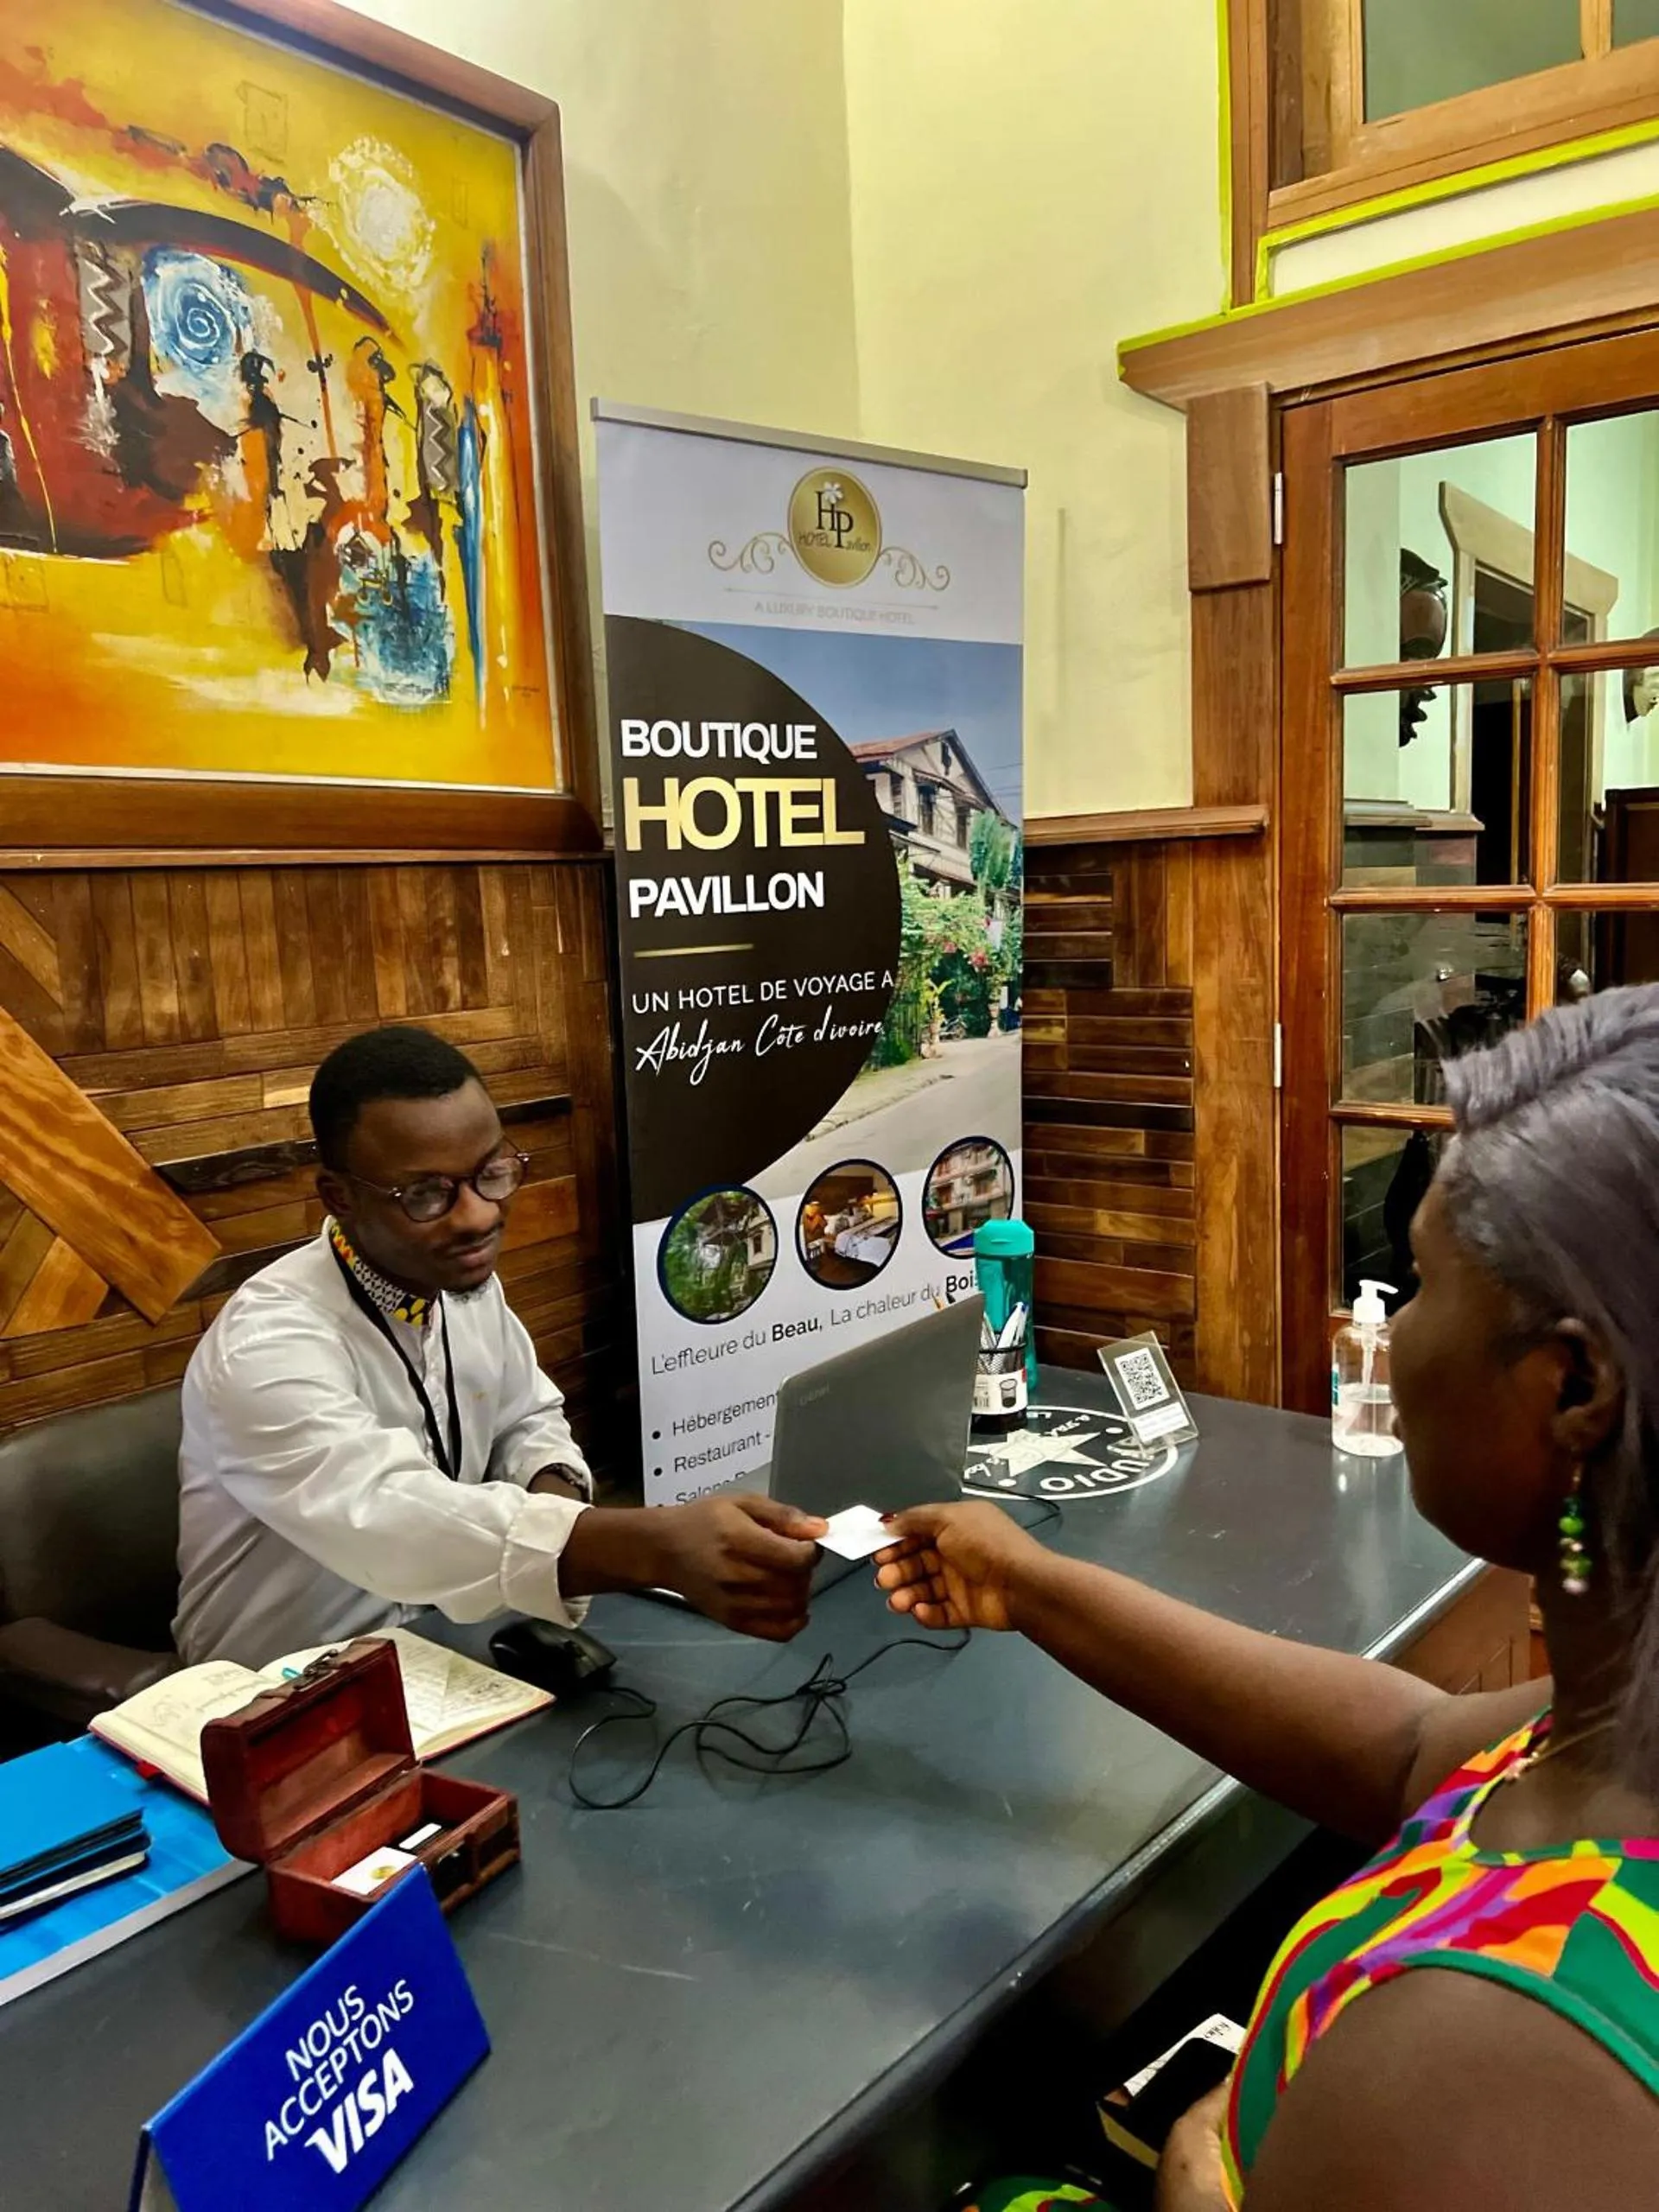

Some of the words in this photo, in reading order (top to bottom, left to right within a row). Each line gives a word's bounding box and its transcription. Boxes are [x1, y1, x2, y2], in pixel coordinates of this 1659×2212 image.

[817, 606, 877, 621] BOUTIQUE
[879, 611, 916, 625] HOTEL
[620, 719, 817, 765] BOUTIQUE
[623, 776, 866, 851] HOTEL
[629, 871, 824, 918] PAVILLON
[632, 991, 669, 1014] UN
[677, 982, 754, 1009] HOTEL
[760, 978, 786, 1001] DE
[793, 971, 873, 996] VOYAGE
[881, 970, 895, 988] A
[635, 1018, 745, 1085] Abidjan
[754, 1014, 804, 1057] Côte
[651, 1338, 738, 1375] L'effleure
[743, 1330, 766, 1351] du
[772, 1315, 823, 1343] Beau,
[830, 1306, 852, 1325] La
[856, 1288, 917, 1319] chaleur
[921, 1282, 941, 1301] du
[945, 1269, 977, 1294] Boi
[674, 1431, 761, 1472] Restaurant
[285, 1984, 365, 2082] NOUS
[264, 1979, 414, 2162] ACCEPTONS
[304, 2048, 414, 2174] VISA
